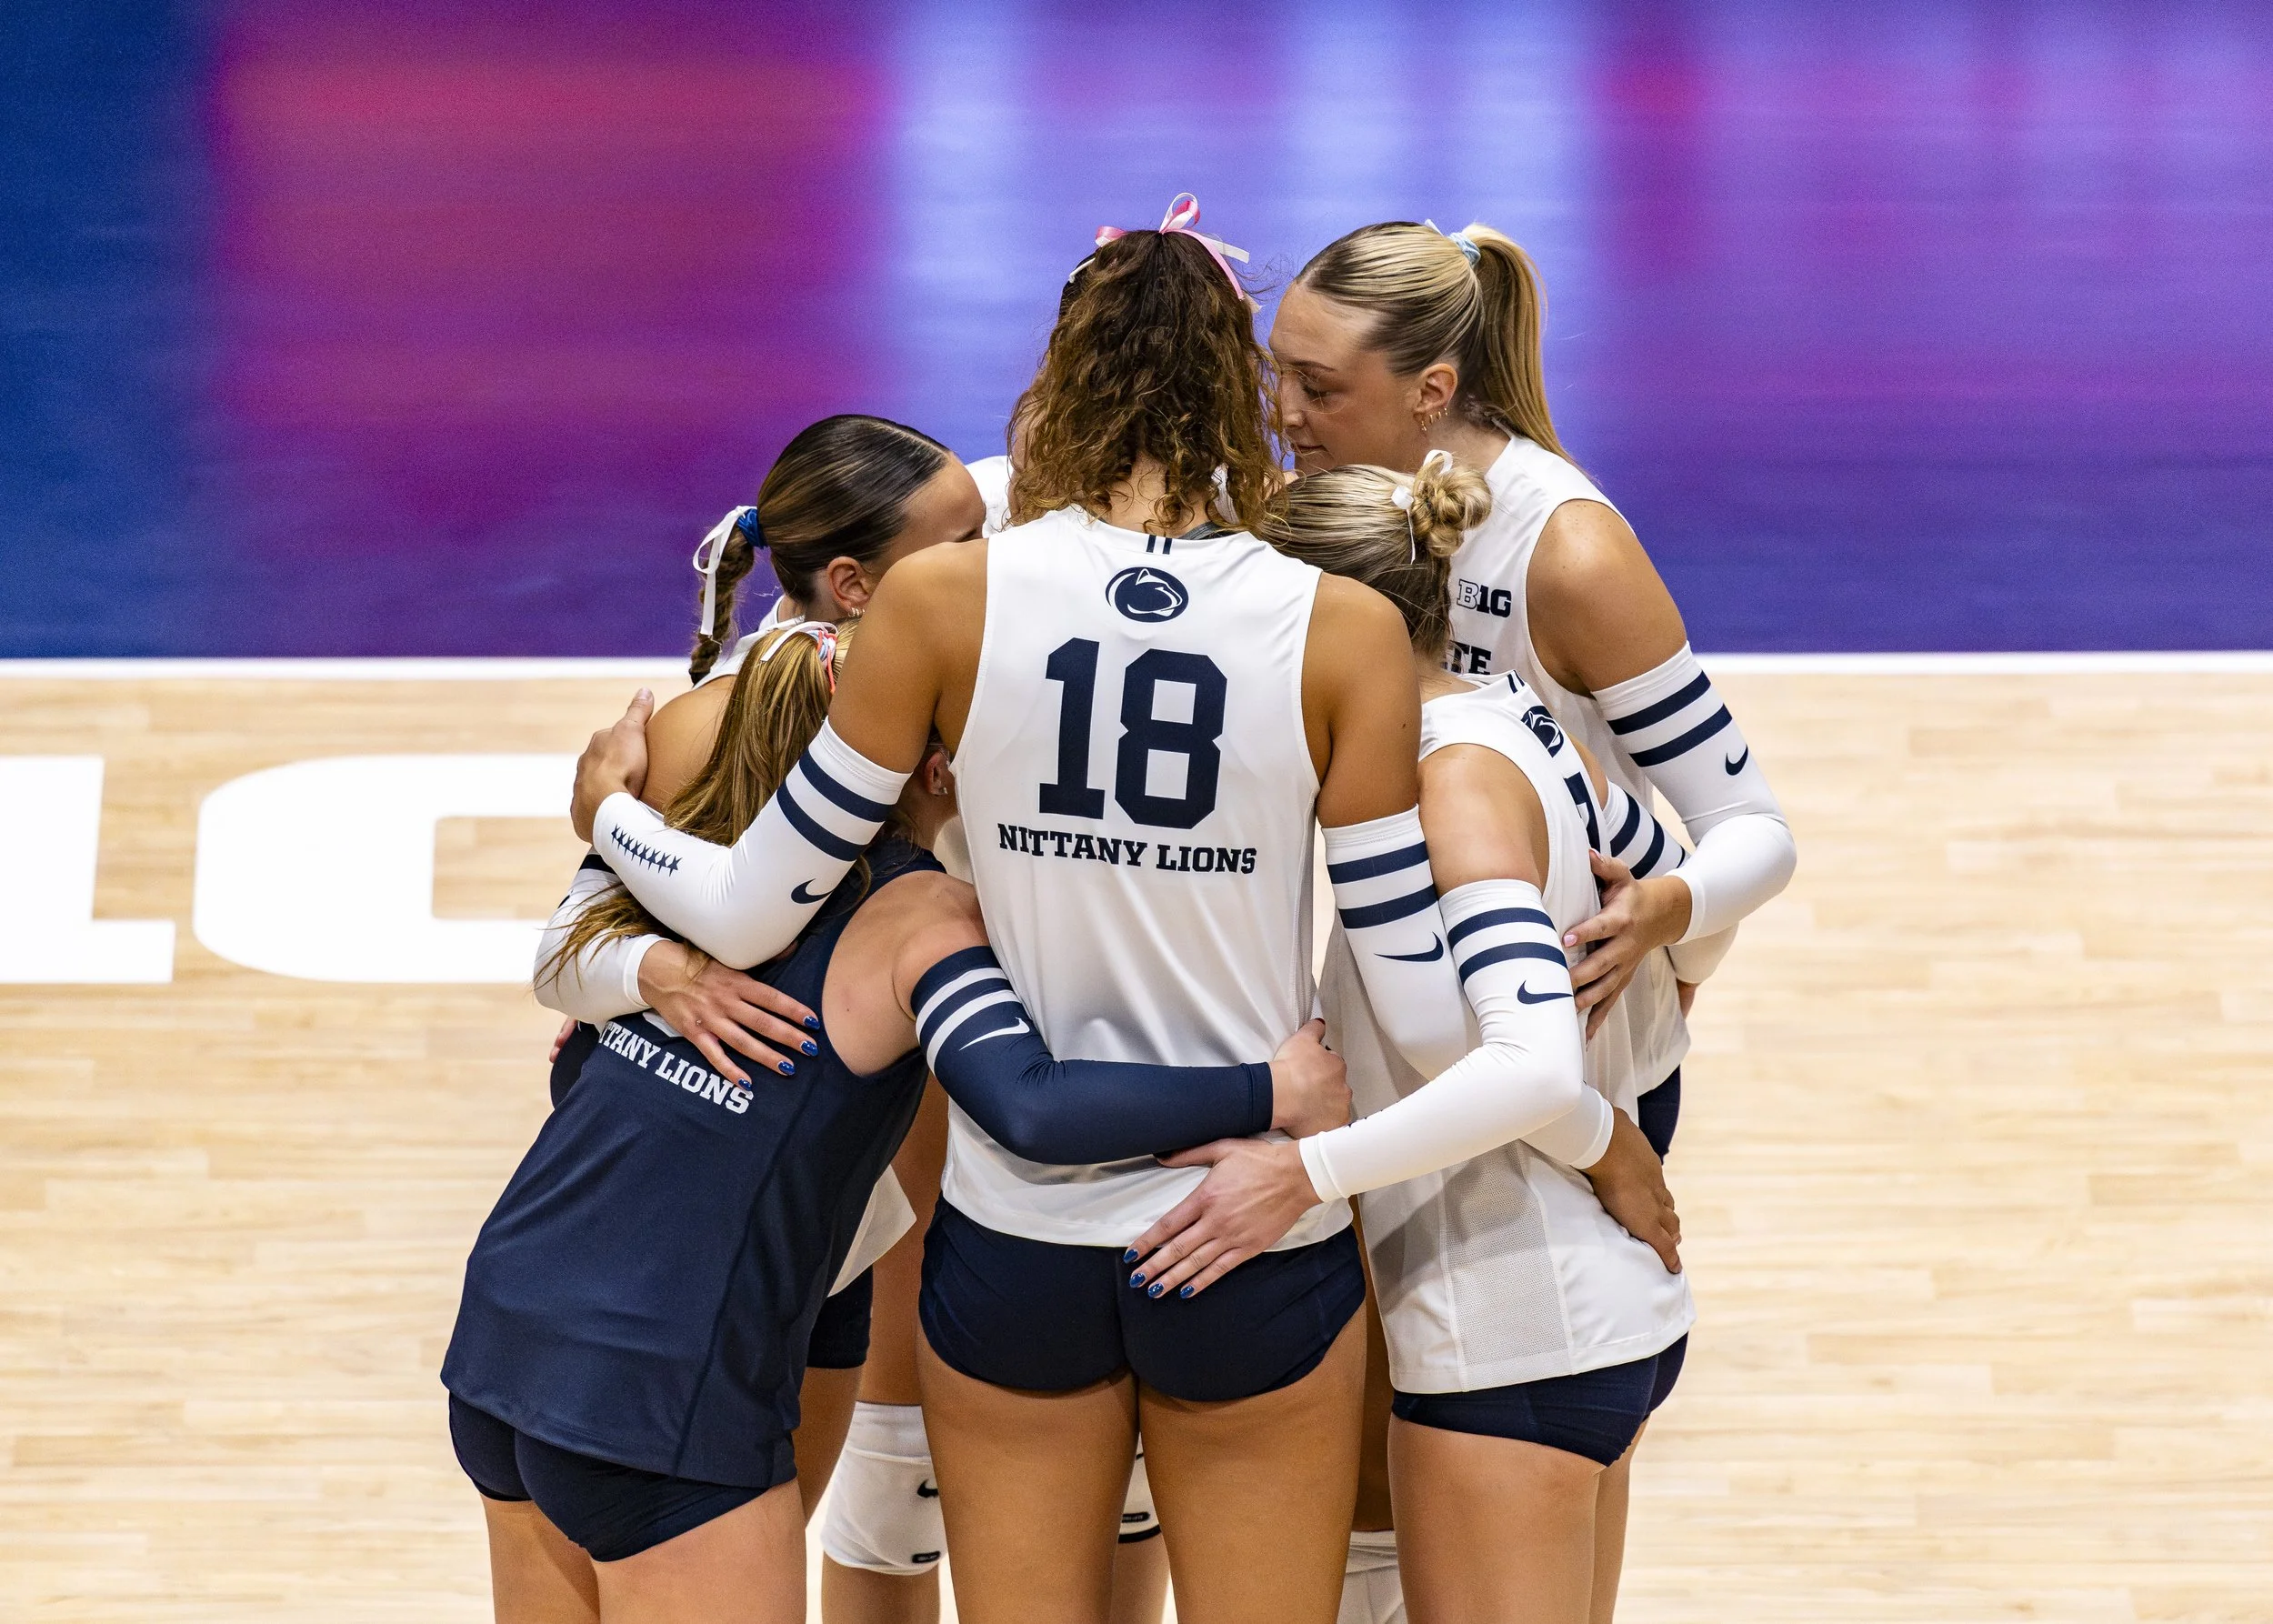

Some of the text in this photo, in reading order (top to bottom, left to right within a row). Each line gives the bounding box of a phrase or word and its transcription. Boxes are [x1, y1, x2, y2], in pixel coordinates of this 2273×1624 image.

[1038, 637, 1228, 830] 18
[997, 822, 1257, 875] NITTANY LIONS
[655, 1051, 755, 1115] LIONS
